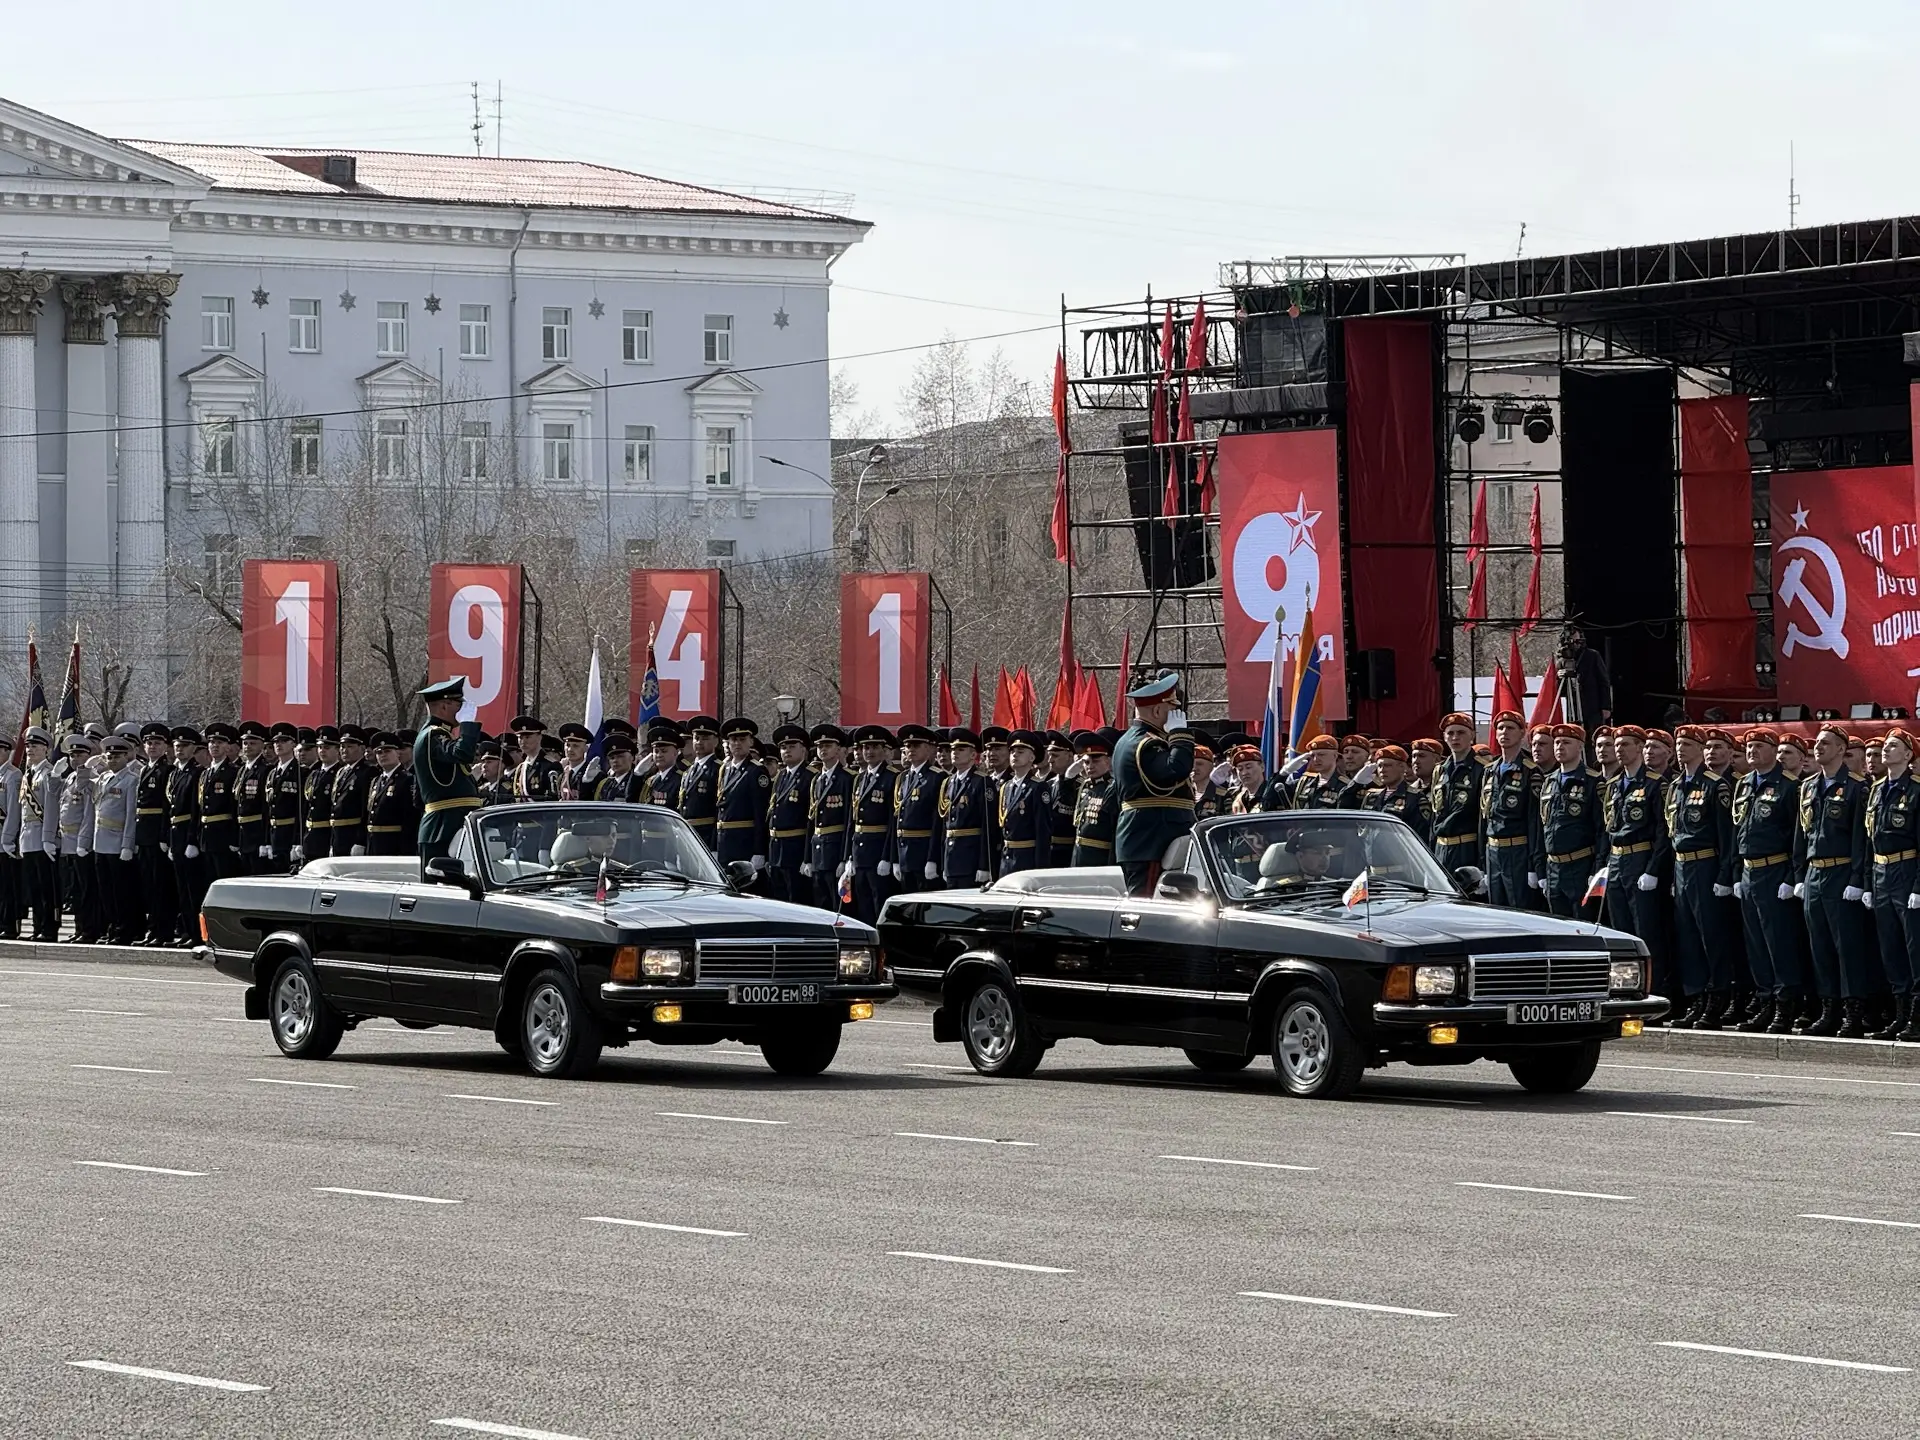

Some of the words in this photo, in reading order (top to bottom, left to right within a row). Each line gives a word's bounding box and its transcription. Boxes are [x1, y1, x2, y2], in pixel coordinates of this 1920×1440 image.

[1856, 525, 1884, 563] 150
[1233, 512, 1320, 663] 9
[1281, 634, 1335, 663] МЯ
[275, 581, 310, 705] 1
[448, 585, 505, 707] 9
[652, 590, 705, 711] 4
[868, 593, 902, 713] 1
[742, 986, 779, 1002] 0002
[801, 985, 815, 997] 88
[1521, 1004, 1558, 1021] 0001
[1578, 1002, 1591, 1015] 88
